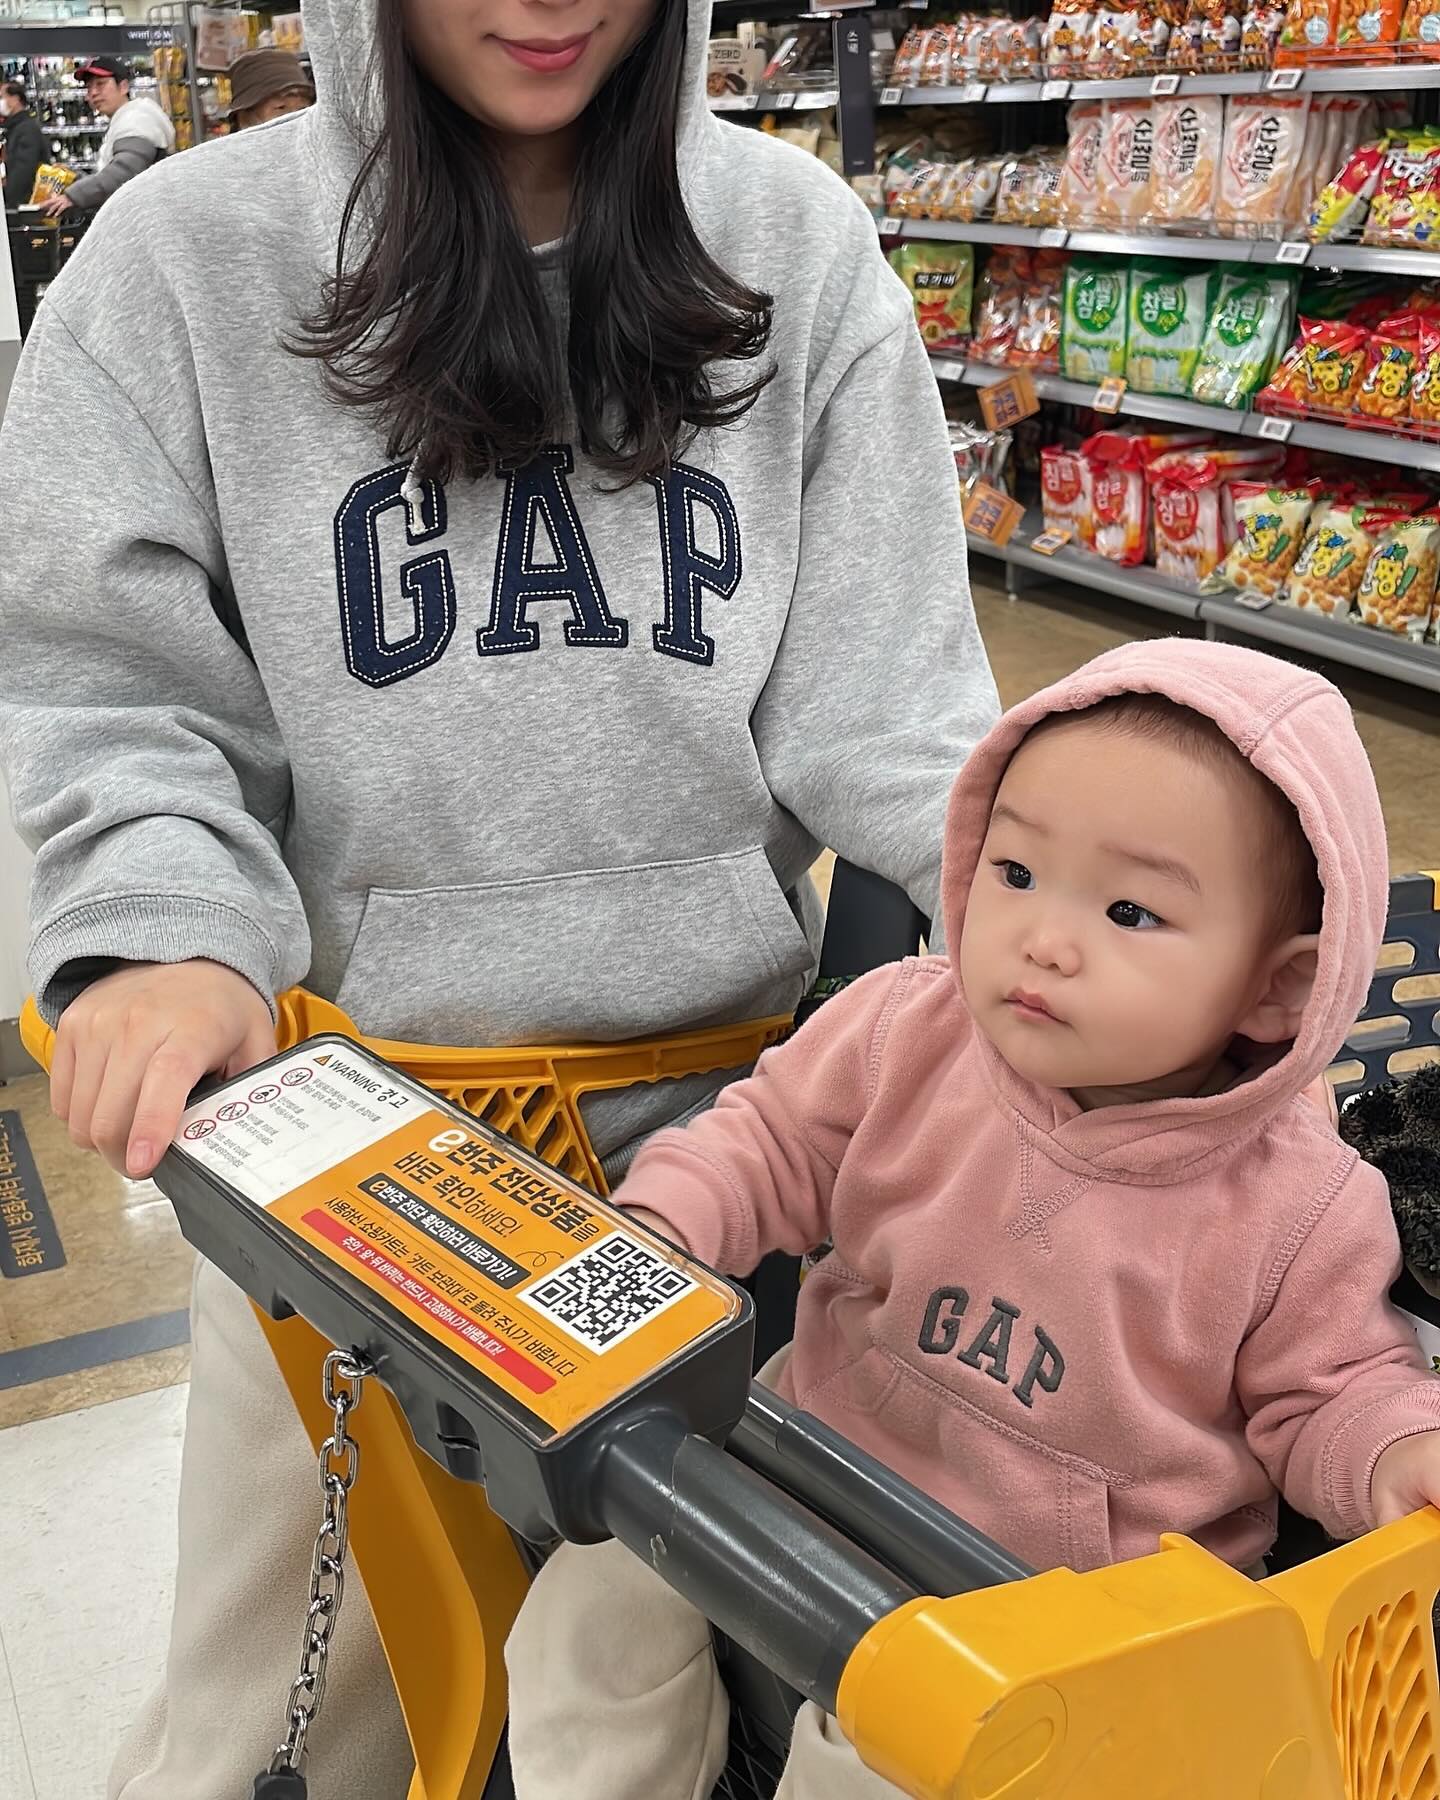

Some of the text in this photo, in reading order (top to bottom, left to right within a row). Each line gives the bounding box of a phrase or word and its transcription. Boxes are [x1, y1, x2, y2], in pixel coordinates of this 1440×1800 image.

[334, 444, 742, 689] GAP
[328, 1060, 410, 1109] WARNING 경고
[370, 1181, 517, 1280] e번주 전단 확인하러 바로가기!
[393, 1151, 523, 1238] 바로 확인하세요!
[428, 1129, 599, 1242] e번주 전단상품을
[324, 1197, 368, 1226] 사용하신
[358, 1222, 409, 1258] 쇼핑카트는
[470, 1301, 500, 1321] 돌려
[494, 1315, 533, 1345] 주시기
[525, 1340, 578, 1377] 바랍니다
[343, 1236, 363, 1251] 주의
[377, 1263, 405, 1283] 바퀴는
[400, 1279, 430, 1302] 반드시
[423, 1297, 469, 1330] 고정하시기
[462, 1325, 505, 1355] 바랍니다!
[918, 1286, 1065, 1408] GAP
